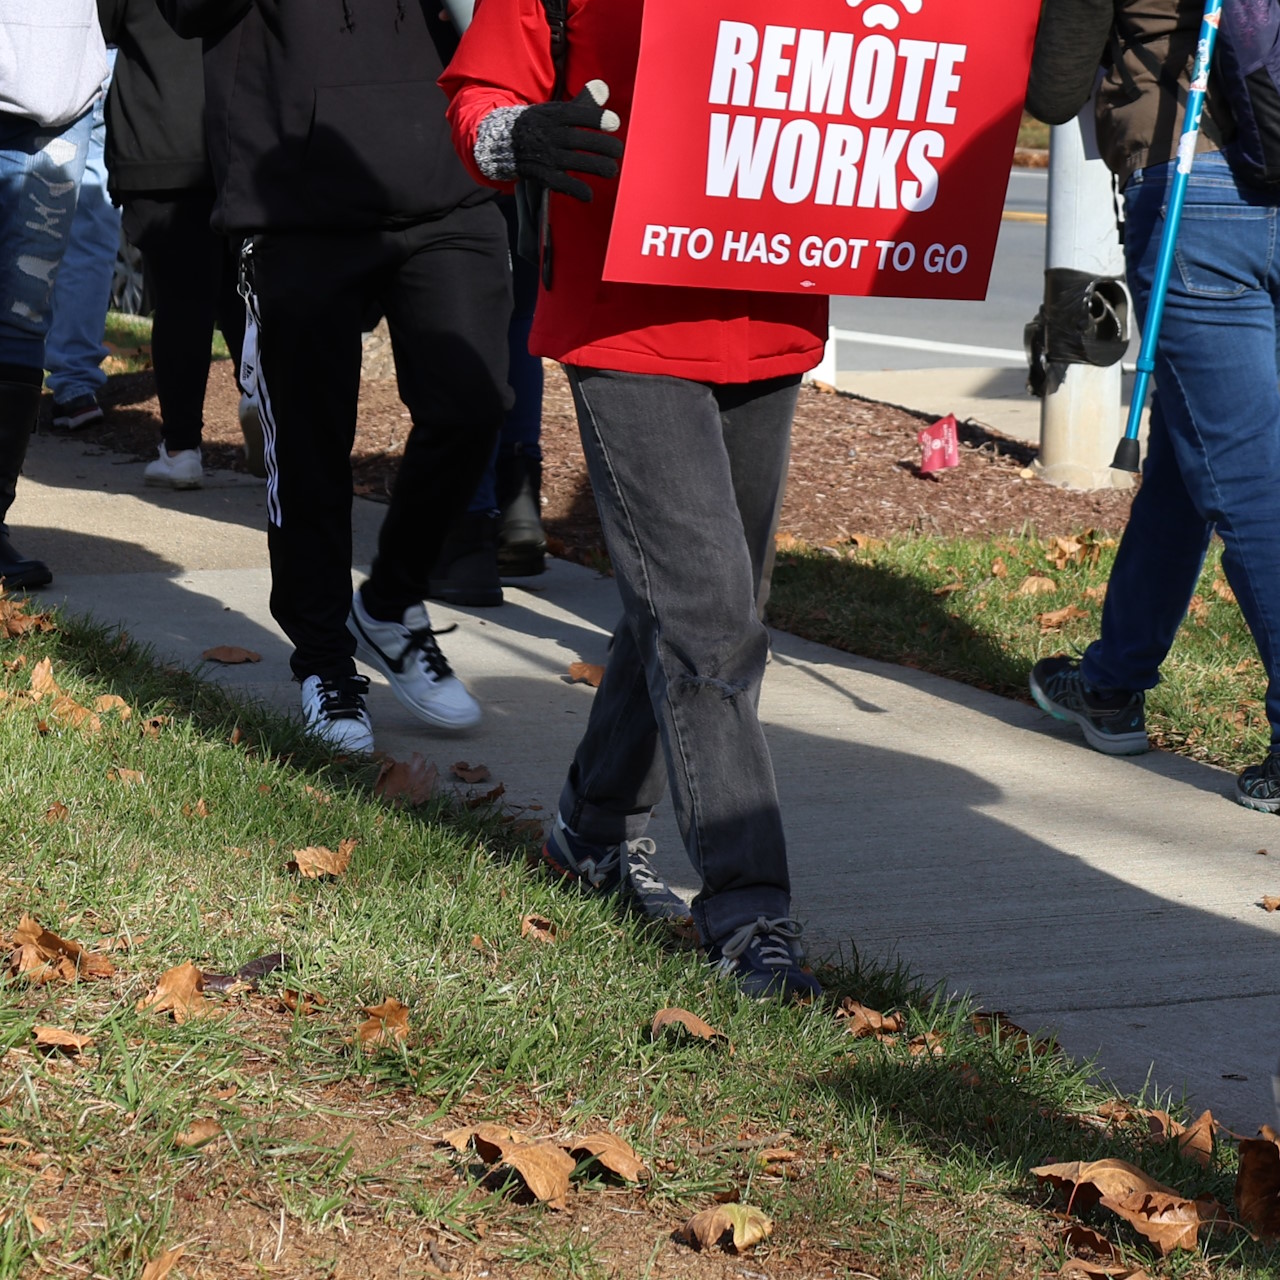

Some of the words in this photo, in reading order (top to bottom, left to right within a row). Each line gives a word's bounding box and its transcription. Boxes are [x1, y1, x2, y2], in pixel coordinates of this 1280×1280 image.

[708, 19, 967, 125] REMOTE
[705, 113, 945, 212] WORKS
[641, 224, 713, 260] RTO
[721, 230, 791, 265] HAS
[798, 236, 869, 270] GOT
[876, 240, 916, 273] TO
[923, 243, 968, 274] GO
